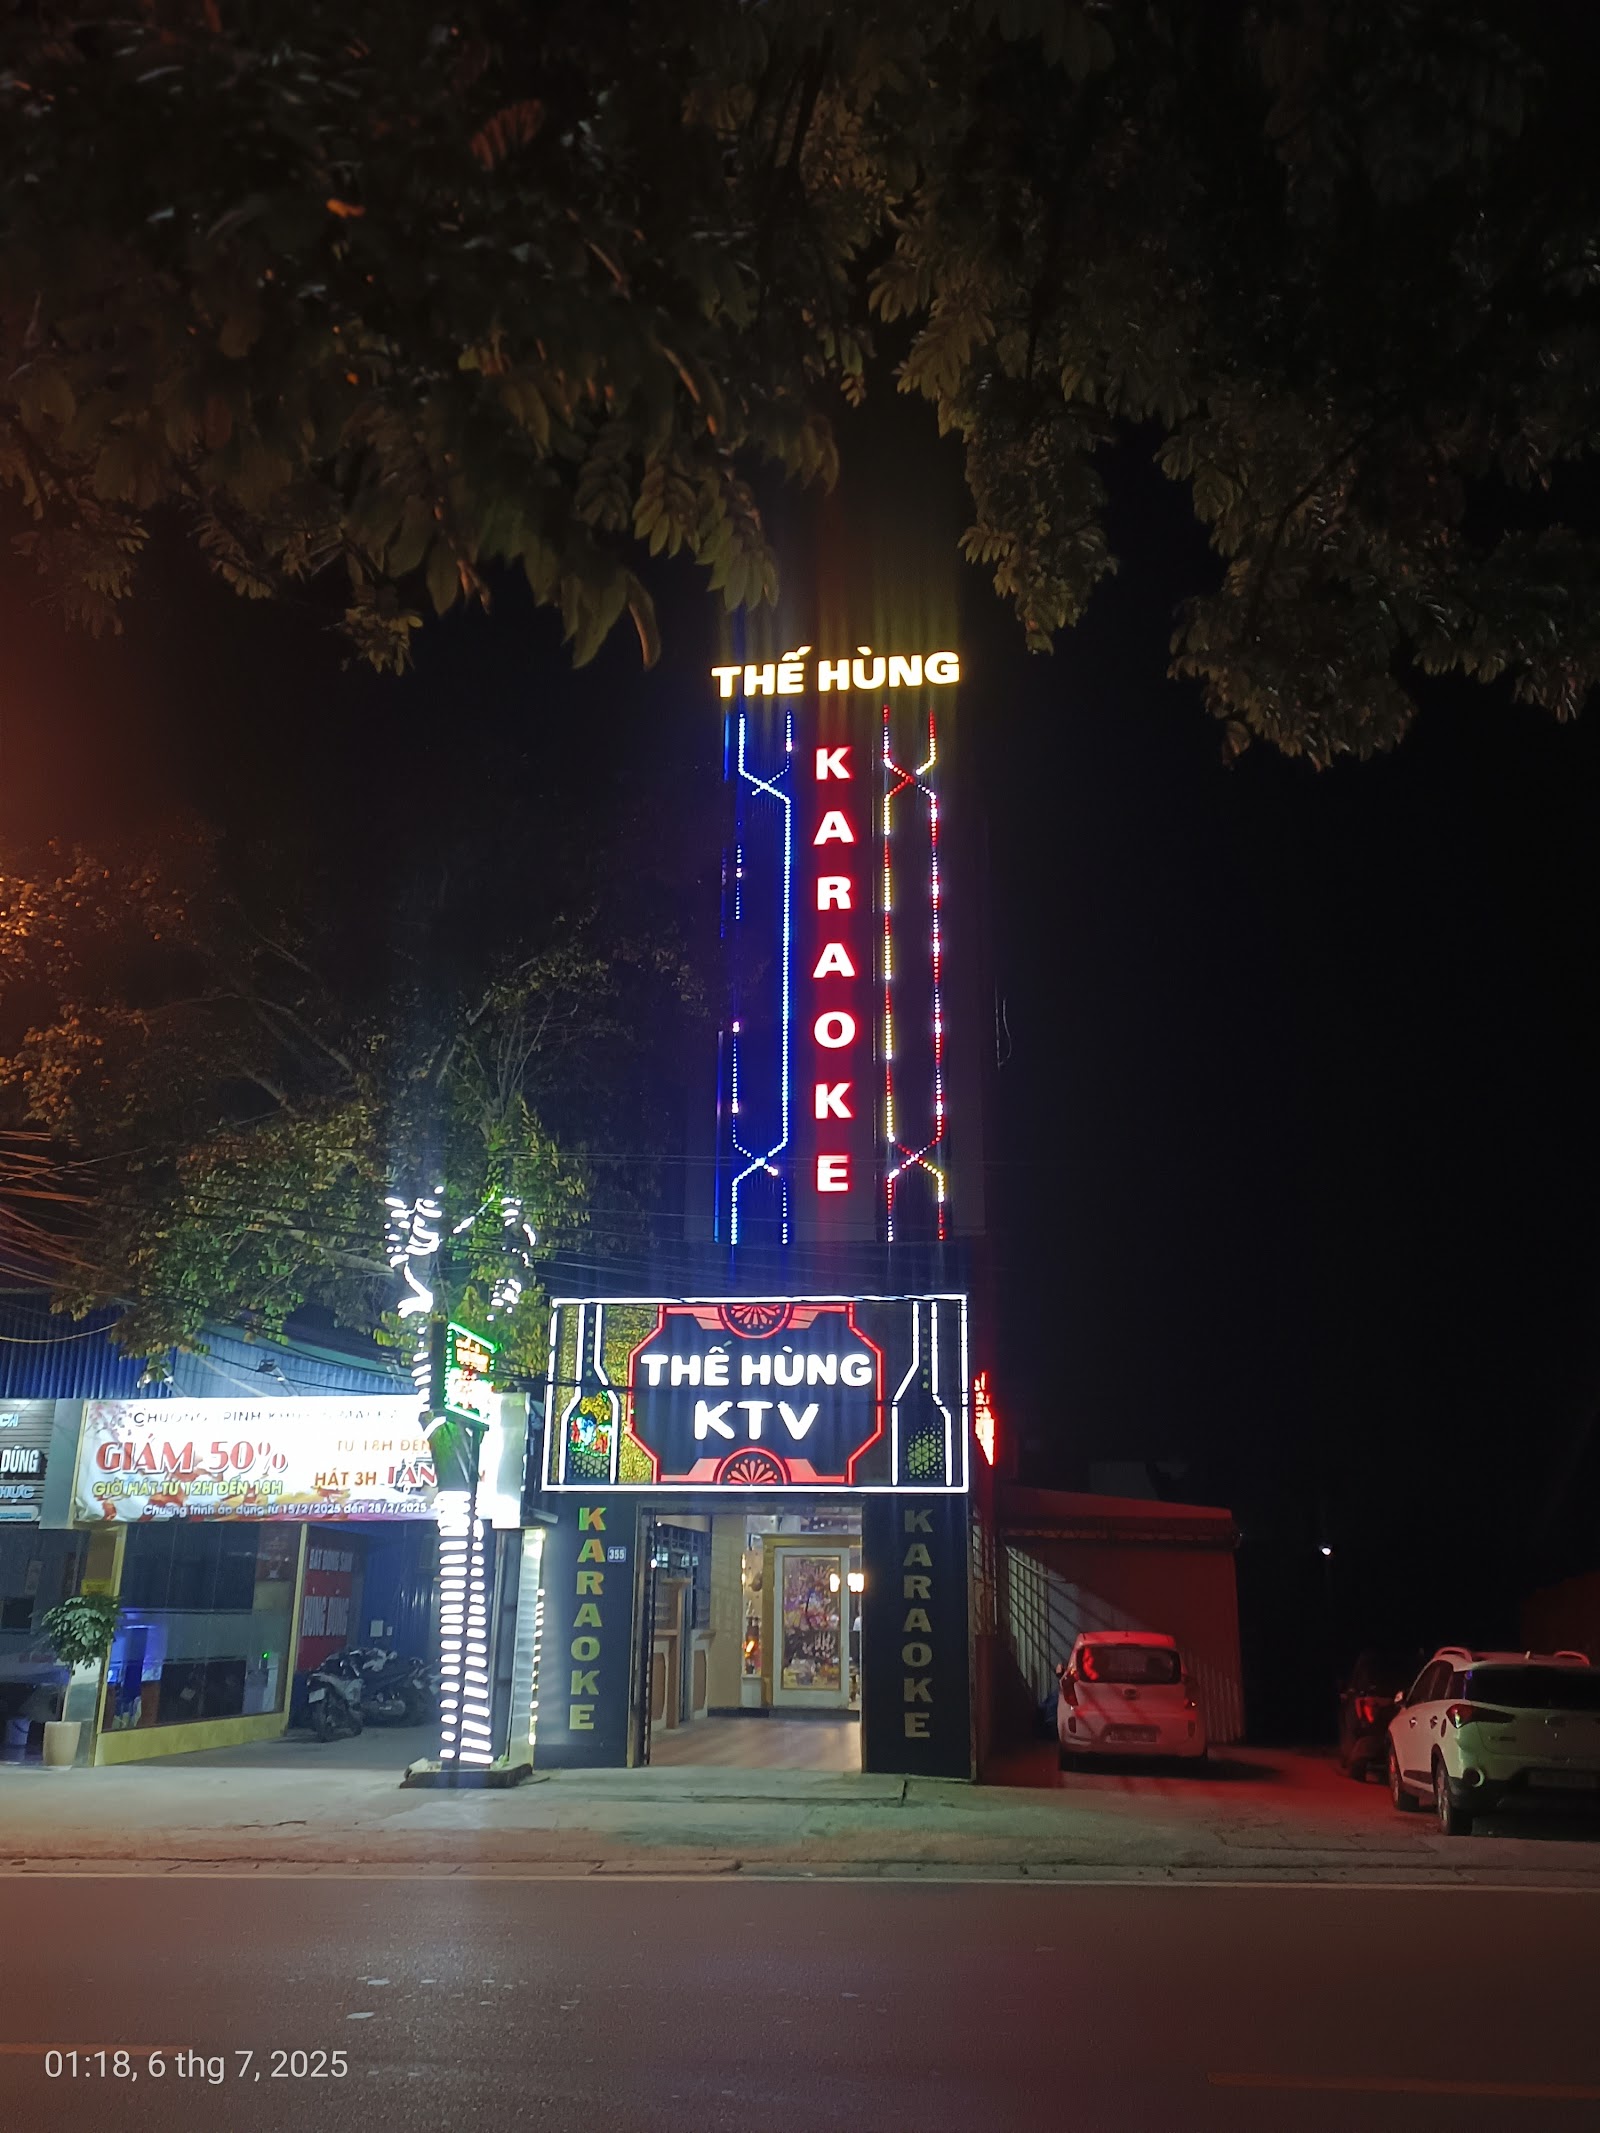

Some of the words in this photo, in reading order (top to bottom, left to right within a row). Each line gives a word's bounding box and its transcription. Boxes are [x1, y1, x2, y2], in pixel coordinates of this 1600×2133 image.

[711, 646, 811, 698] THẾ
[818, 646, 960, 692] HÙNG
[813, 747, 855, 1192] KARAOKE
[641, 1340, 732, 1386] THẾ
[741, 1346, 872, 1387] HÙNG
[694, 1400, 819, 1440] KTV
[209, 1441, 288, 1474] 50%
[314, 1468, 348, 1487] HÁT
[354, 1472, 377, 1485] 3H
[92, 1477, 124, 1496] GIỜ
[127, 1477, 157, 1496] HÁT
[184, 1480, 213, 1496] 12H
[217, 1474, 249, 1496] ĐẾN
[254, 1480, 283, 1496] 18H
[609, 1549, 625, 1560] 355
[569, 1507, 606, 1730] KARAOKE
[902, 1509, 933, 1738] KARAOKE
